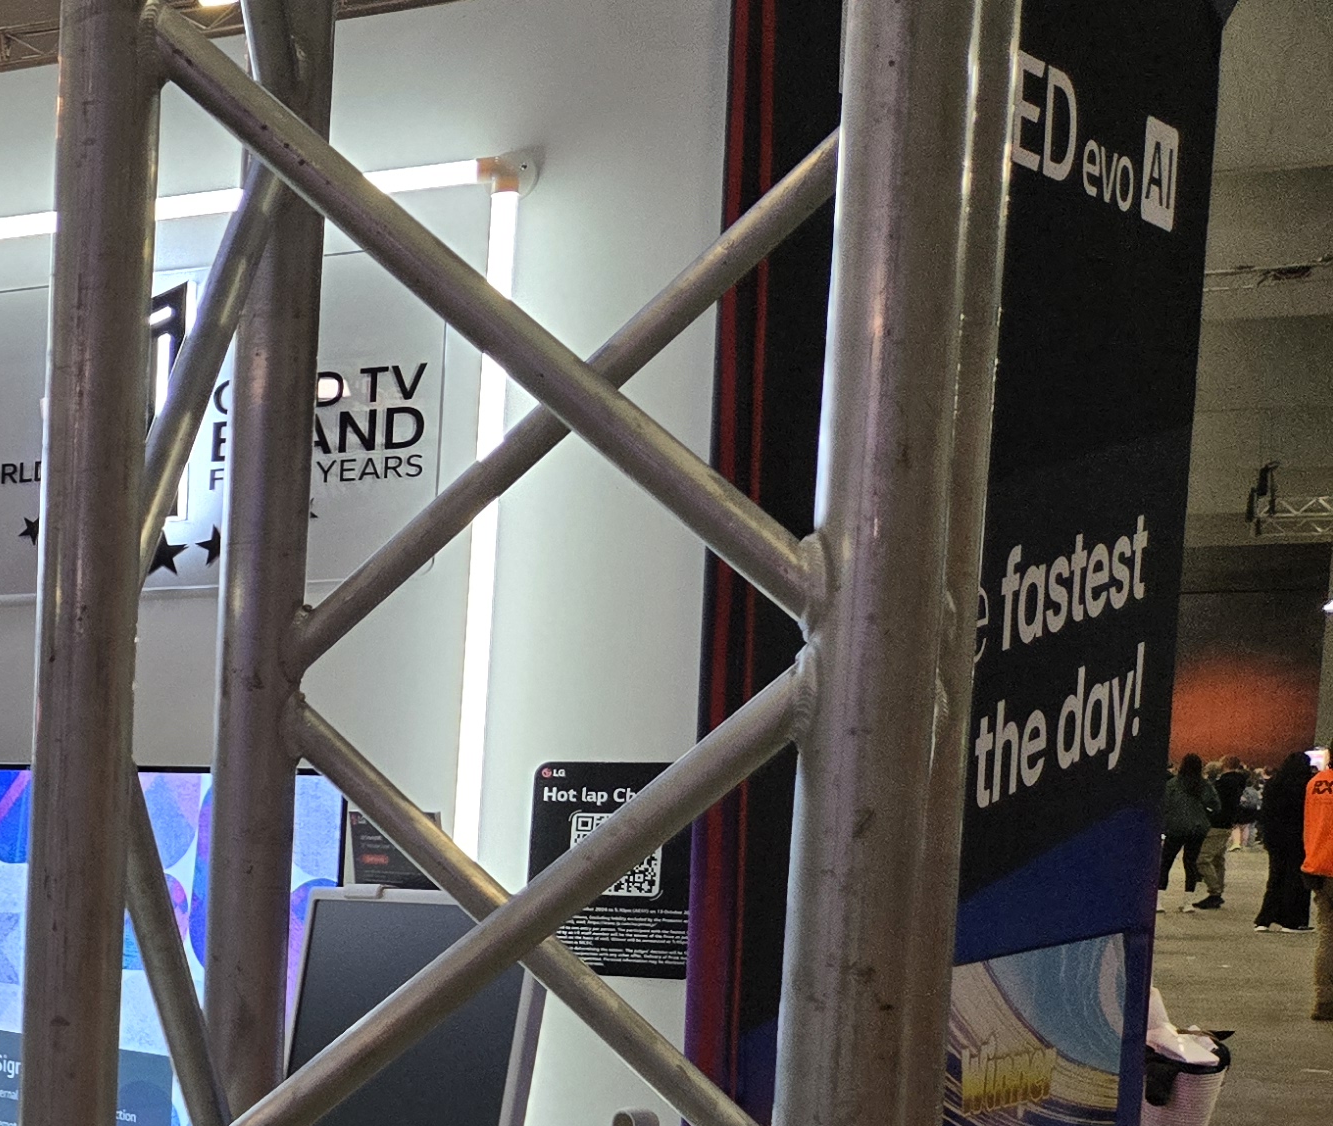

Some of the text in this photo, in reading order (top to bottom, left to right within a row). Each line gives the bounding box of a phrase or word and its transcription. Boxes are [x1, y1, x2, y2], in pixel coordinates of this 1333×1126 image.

[1012, 50, 1176, 219] ED evo AI
[360, 362, 428, 403] TV
[317, 454, 423, 483] YEARS
[1001, 514, 1148, 652] fastest
[975, 641, 1145, 808] the day!
[553, 768, 566, 777] LG
[543, 786, 578, 803] Hot
[582, 786, 608, 806] lap
